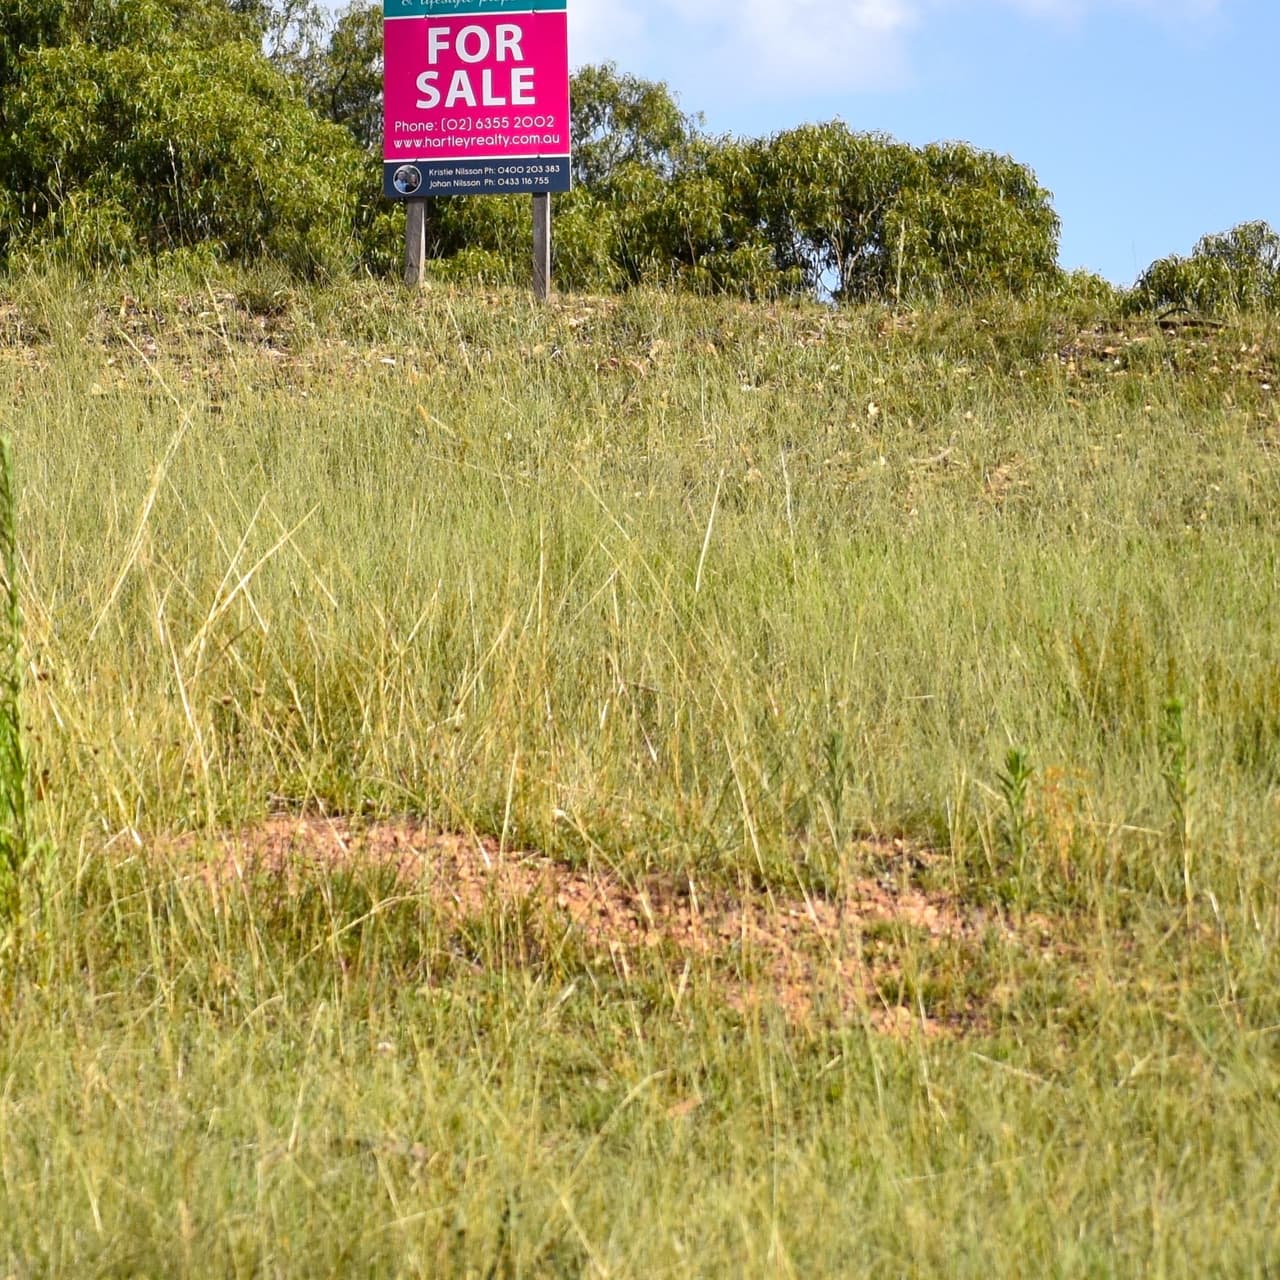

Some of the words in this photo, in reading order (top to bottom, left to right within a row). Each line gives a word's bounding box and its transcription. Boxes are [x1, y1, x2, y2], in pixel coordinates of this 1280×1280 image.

[427, 23, 525, 66] FOR
[415, 66, 536, 110] SALE
[394, 120, 438, 134] Phone:
[440, 117, 472, 133] (02)
[475, 116, 510, 130] 6355
[513, 115, 555, 129] 2002
[393, 132, 561, 150] www.hartleyrealty.com.au
[428, 168, 454, 177] Kristie
[455, 167, 483, 176] Nilsson
[484, 166, 496, 175] Ph:
[497, 165, 525, 175] 0400
[526, 165, 544, 174] 203
[544, 164, 561, 174] 383
[428, 180, 452, 190] Johan
[453, 179, 481, 188] Nilsson
[484, 178, 496, 187] Ph:
[497, 177, 520, 186] 0433
[521, 177, 533, 185] 116
[534, 176, 550, 185] 755
